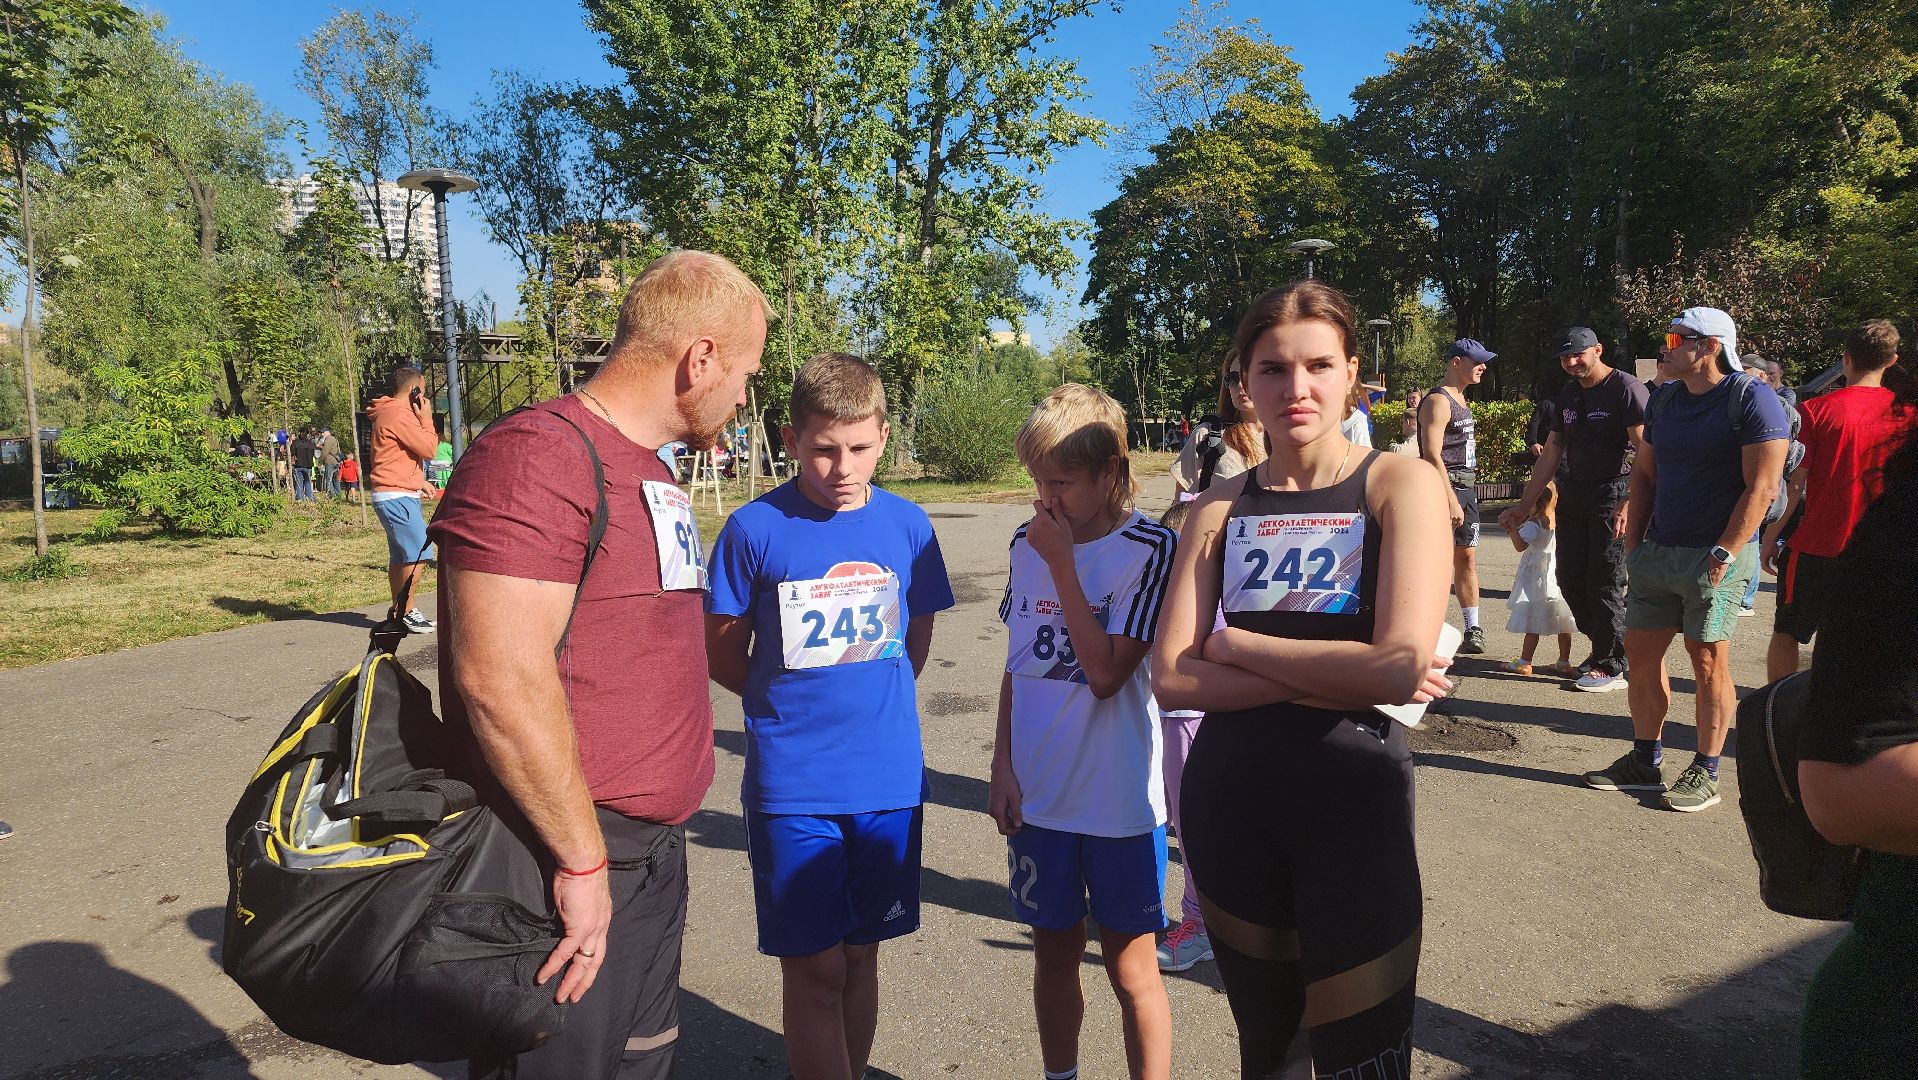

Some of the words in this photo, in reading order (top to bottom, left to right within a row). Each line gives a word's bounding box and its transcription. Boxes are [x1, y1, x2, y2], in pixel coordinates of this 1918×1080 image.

[1257, 528, 1280, 537] ЗАБЕГ
[1258, 518, 1351, 528] ЛЕГКОАТЛЕТИЧЕСКИЙ
[1241, 547, 1336, 590] 242
[801, 604, 884, 648] 243
[1033, 625, 1077, 664] 83
